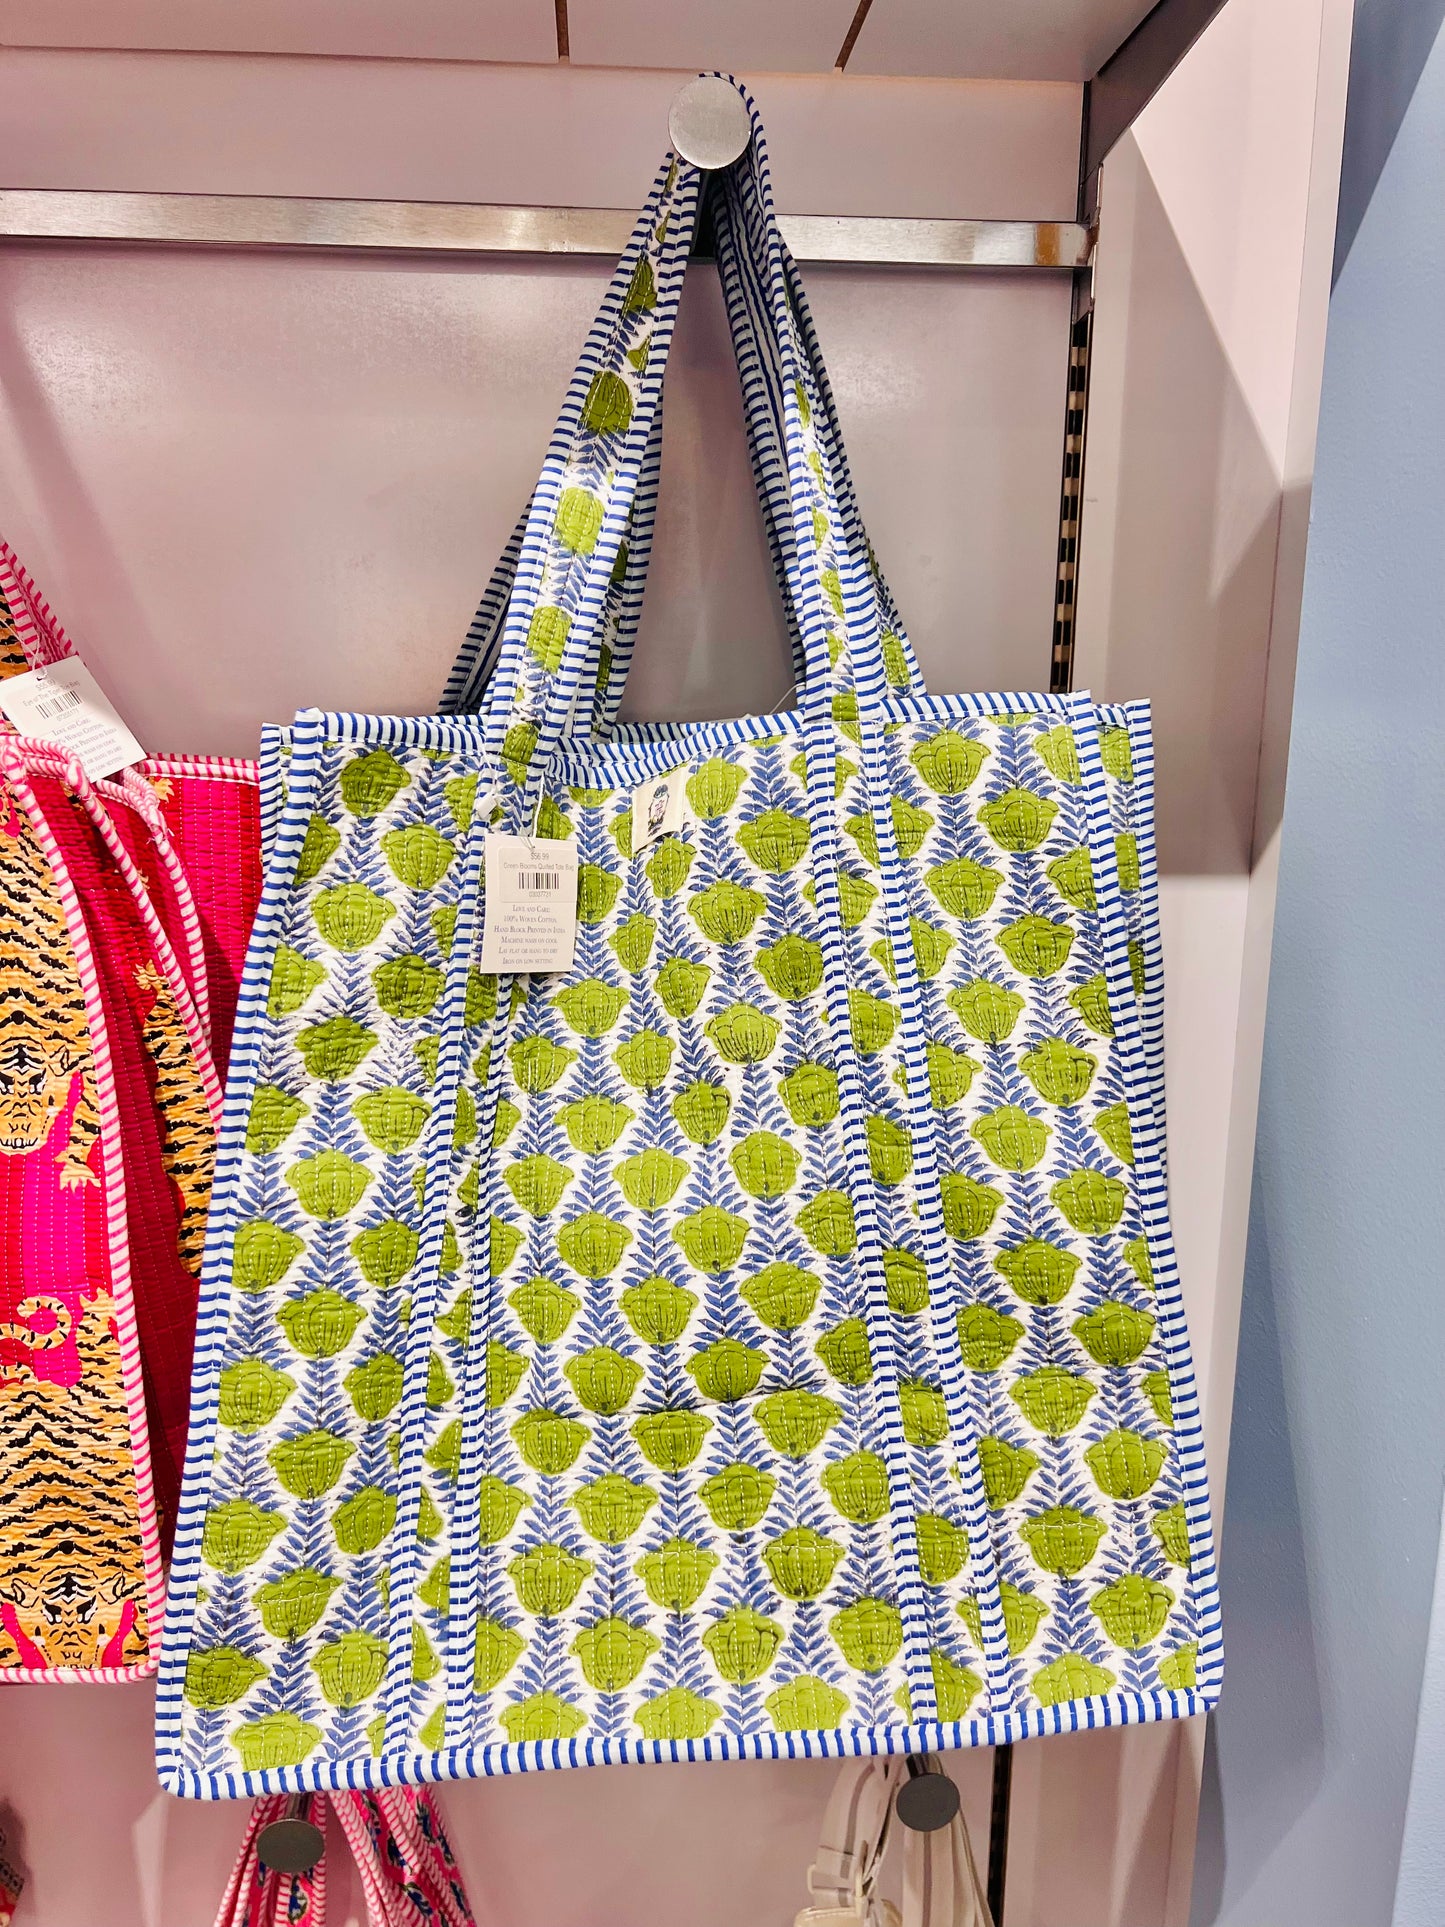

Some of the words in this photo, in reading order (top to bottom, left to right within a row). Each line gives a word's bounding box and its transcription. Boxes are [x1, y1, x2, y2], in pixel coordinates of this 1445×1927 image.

[531, 852, 549, 860] $56.99
[519, 862, 537, 870] Blooms
[538, 863, 555, 871] Quilted
[555, 863, 565, 871] Tote
[565, 864, 574, 872] Bag
[512, 904, 525, 912] LOVE
[503, 915, 518, 923] 100%
[519, 915, 537, 923] WOVEN
[494, 925, 509, 933] HAND
[509, 925, 526, 933] BLOCK
[527, 926, 547, 934] PRINTED
